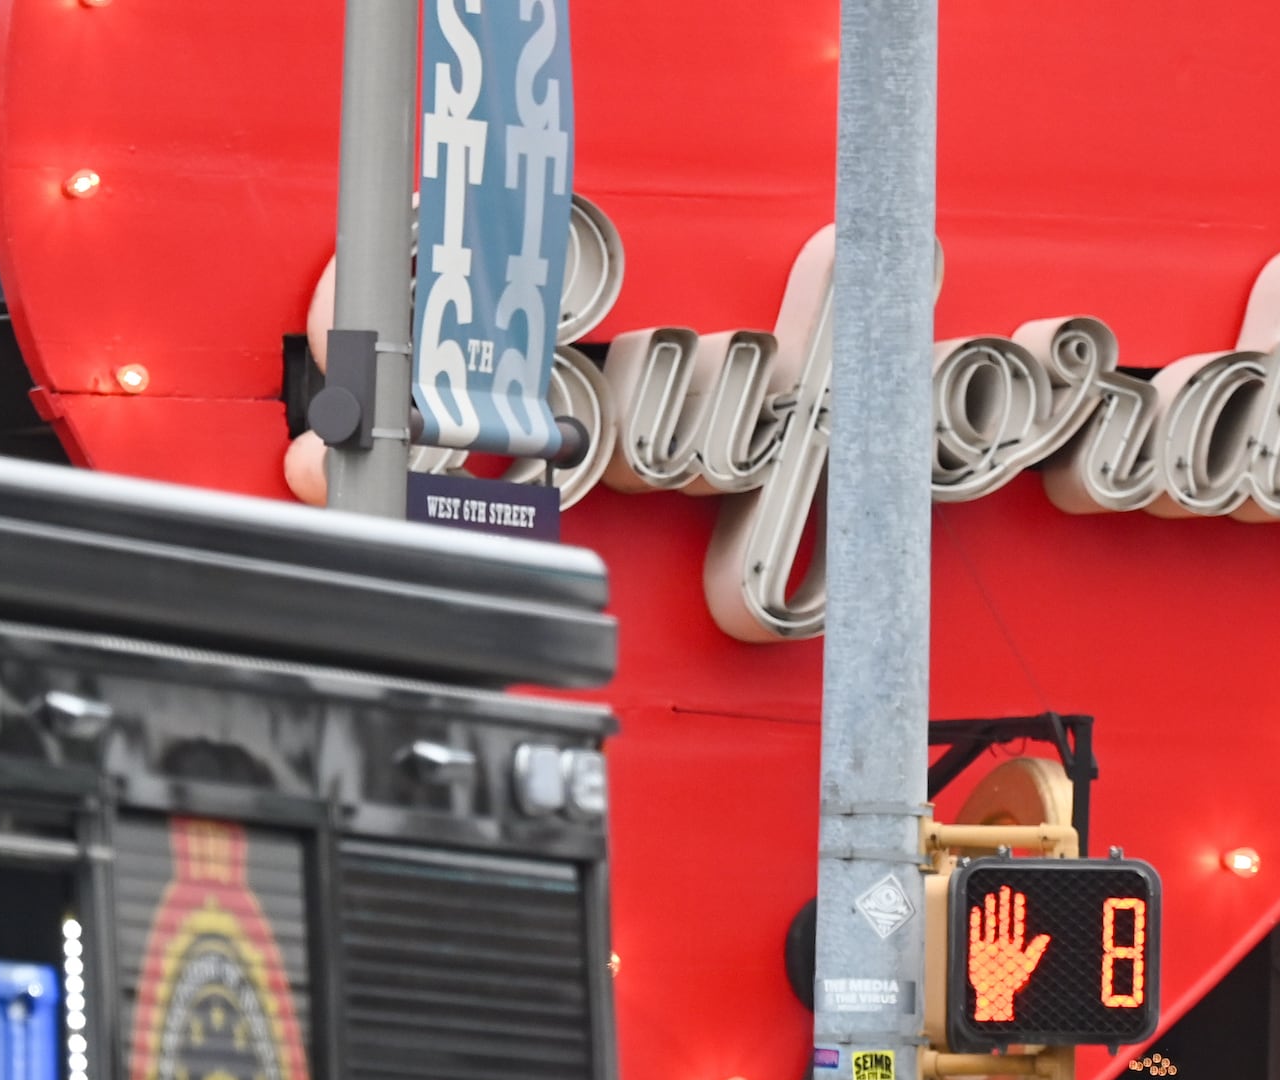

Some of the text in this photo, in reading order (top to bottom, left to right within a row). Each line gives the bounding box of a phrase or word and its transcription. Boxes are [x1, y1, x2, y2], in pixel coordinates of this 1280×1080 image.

[427, 495, 536, 529] WEST 6TH STREET
[1101, 897, 1146, 1008] 8
[848, 979, 899, 993] MEDIA
[859, 993, 898, 1005] VIRUS
